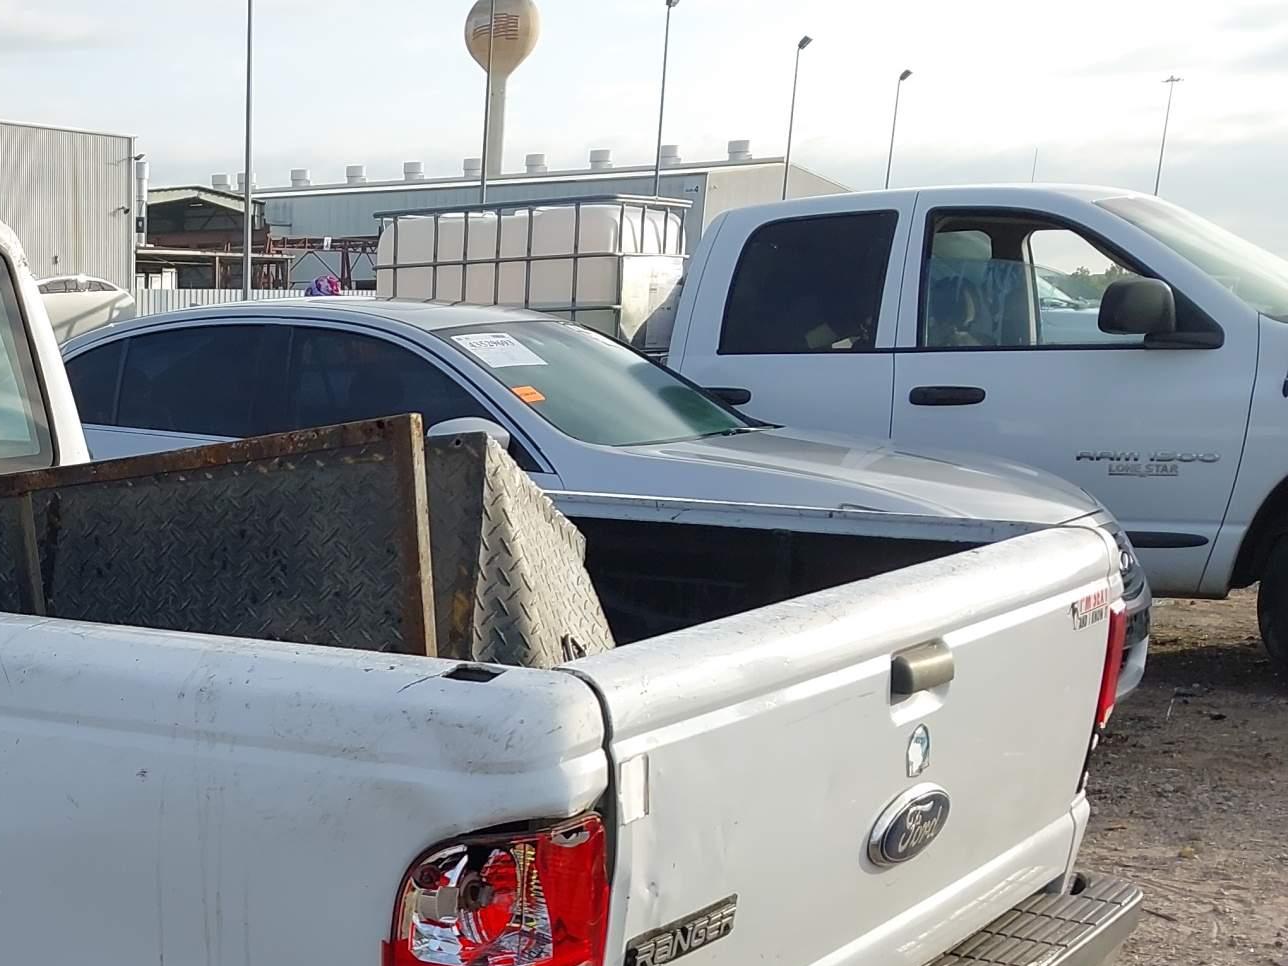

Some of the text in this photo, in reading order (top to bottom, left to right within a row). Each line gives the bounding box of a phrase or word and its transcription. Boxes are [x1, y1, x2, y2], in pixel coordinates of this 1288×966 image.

[1108, 463, 1179, 474] LONE STAR
[898, 800, 943, 853] Ford
